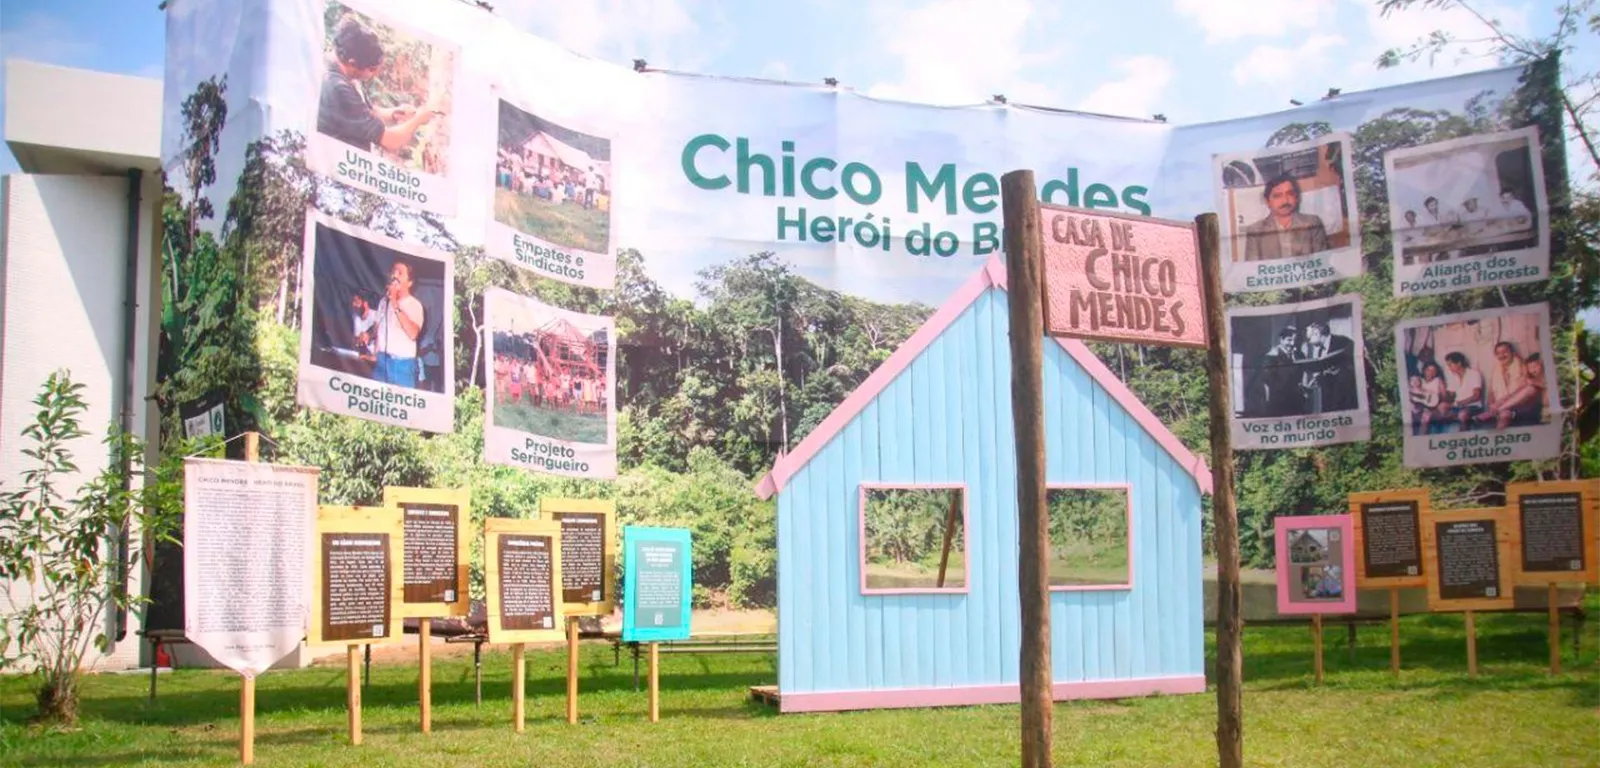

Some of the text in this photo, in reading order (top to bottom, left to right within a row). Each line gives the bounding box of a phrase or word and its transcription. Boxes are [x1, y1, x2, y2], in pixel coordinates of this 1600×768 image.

[338, 161, 428, 203] Seringueiro
[346, 150, 420, 188] Um Sábio
[681, 133, 1152, 216] Chico Medes
[777, 206, 891, 252] Herói
[905, 222, 960, 257] do
[1052, 215, 1137, 252] CASA DE
[513, 234, 584, 267] Empates e
[515, 248, 585, 280] Sindicatos
[1085, 248, 1177, 298] CHICO
[1246, 267, 1336, 288] Extrativistas
[1257, 258, 1322, 275] Reservas
[1400, 264, 1540, 293] Povos da floresta
[1423, 255, 1517, 278] Aliança dos
[1069, 289, 1186, 338] MENDES
[329, 376, 427, 409] Consciência
[347, 395, 409, 420] Política
[1243, 415, 1353, 434] Voz da floresta
[1260, 429, 1336, 444] no mundo
[526, 437, 575, 458] Projeto
[1428, 431, 1532, 451] Legado para
[1446, 446, 1512, 461] o futuro
[511, 448, 590, 472] Seringueiro
